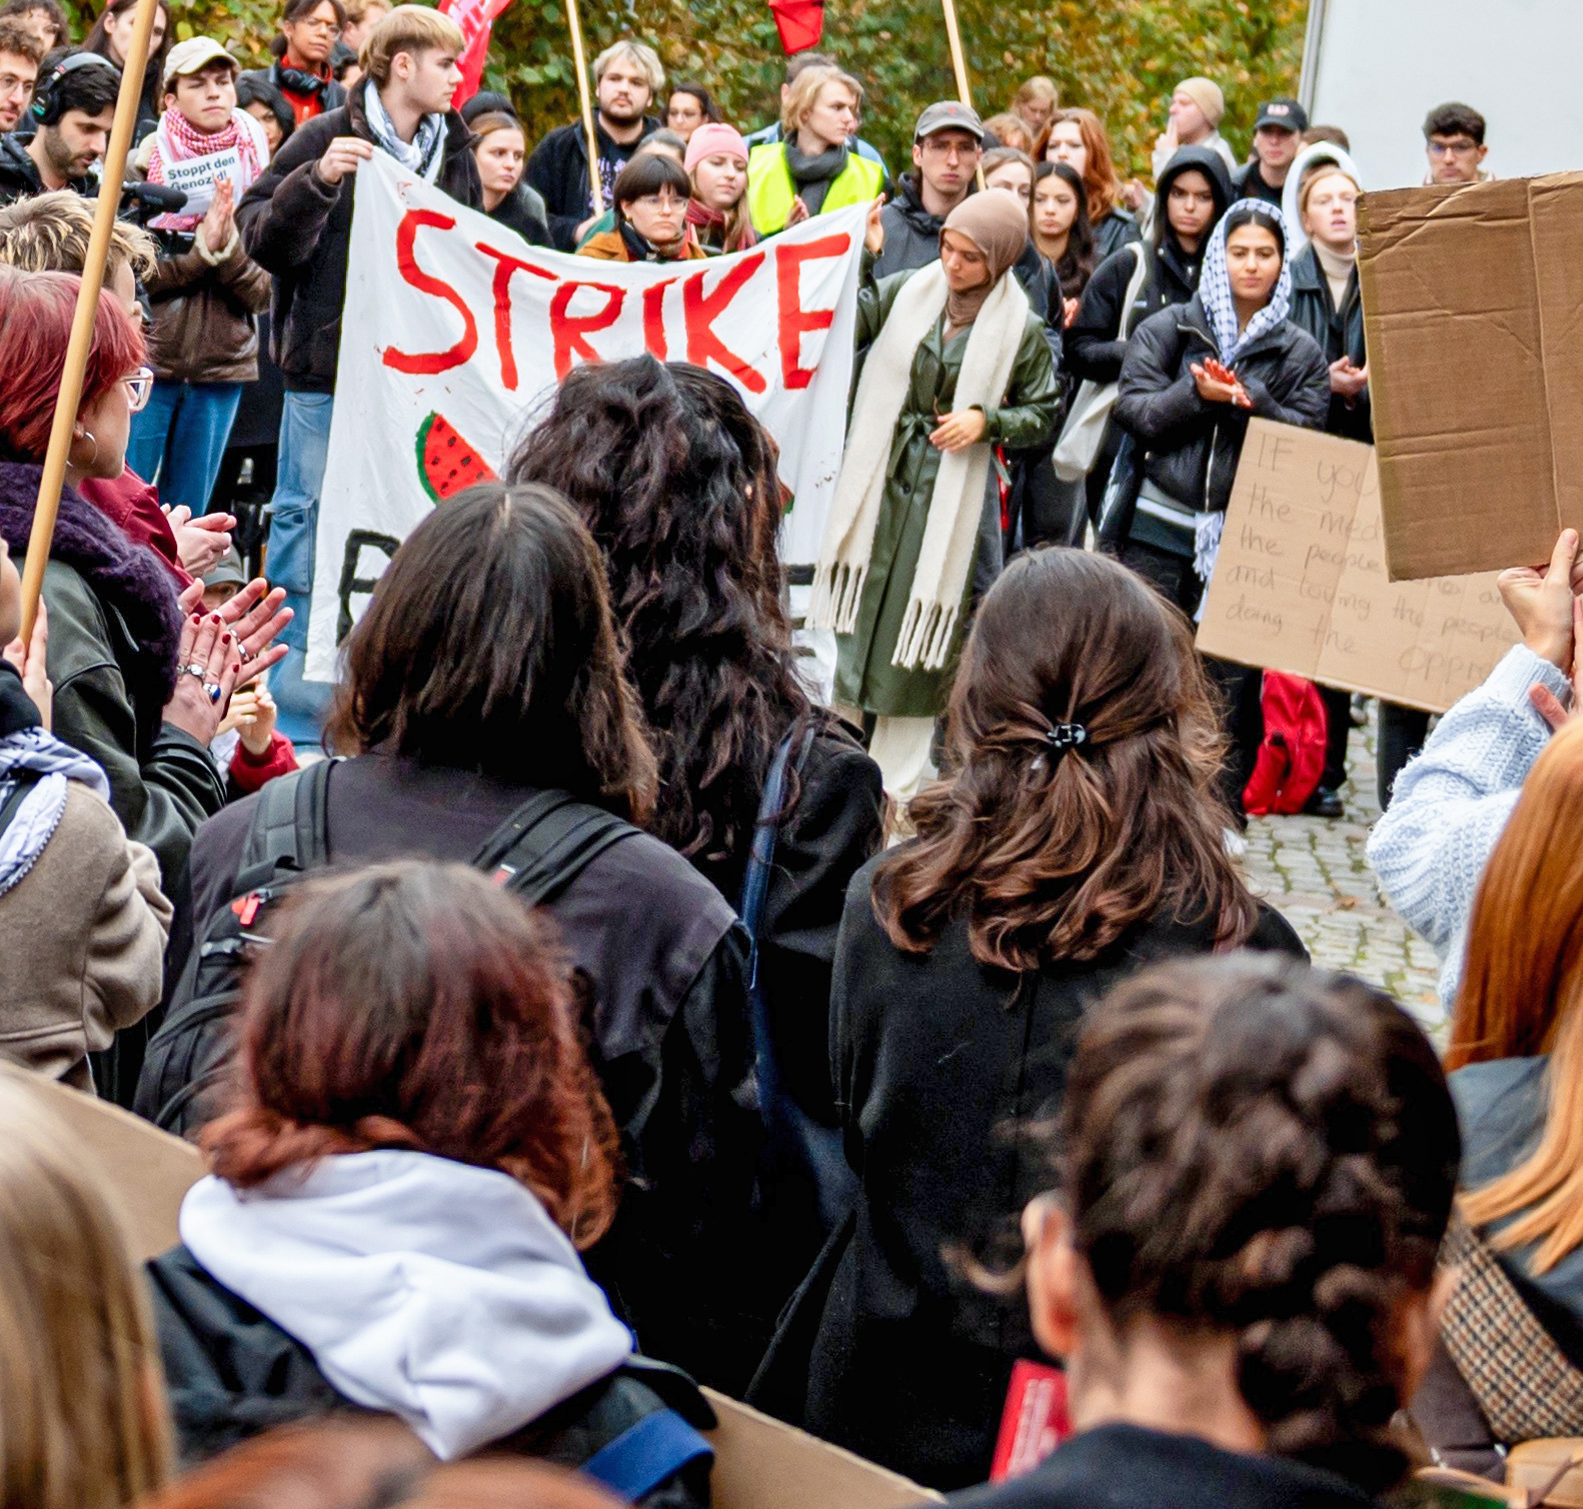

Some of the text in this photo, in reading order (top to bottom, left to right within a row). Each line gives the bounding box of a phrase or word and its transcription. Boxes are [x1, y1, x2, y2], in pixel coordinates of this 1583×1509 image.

[167, 155, 236, 180] Stoppt den
[381, 208, 851, 395] STRIKE
